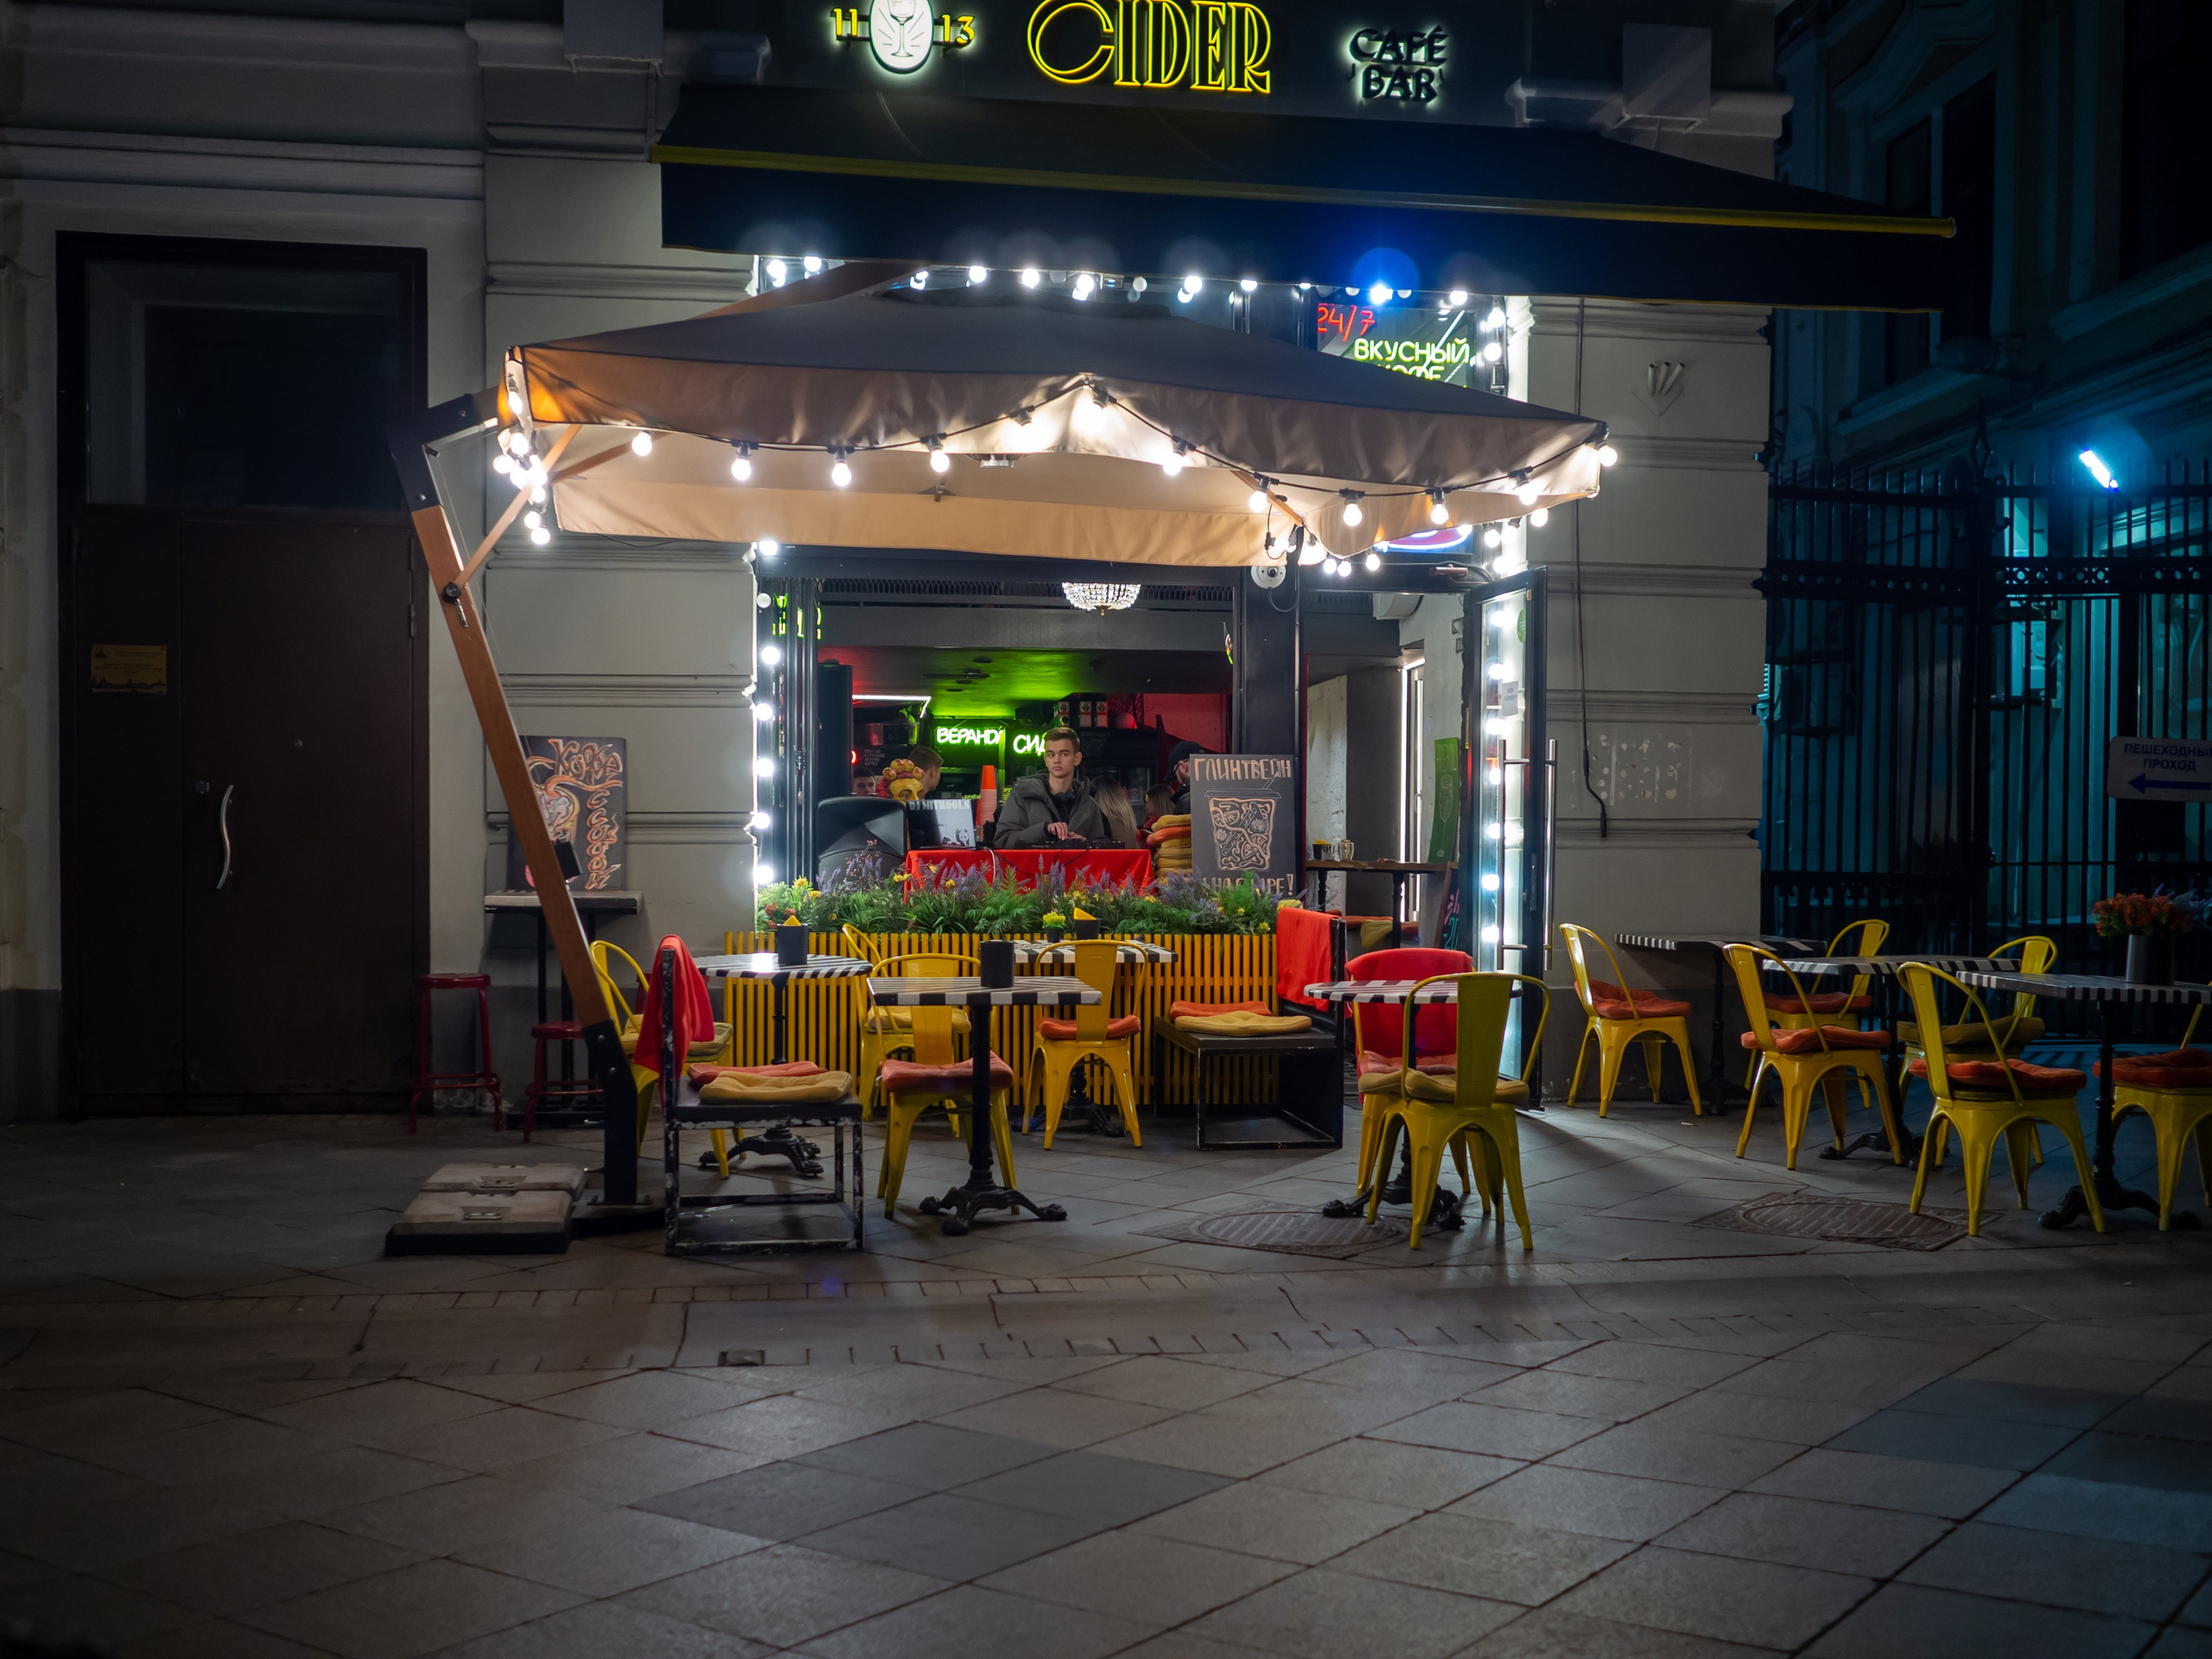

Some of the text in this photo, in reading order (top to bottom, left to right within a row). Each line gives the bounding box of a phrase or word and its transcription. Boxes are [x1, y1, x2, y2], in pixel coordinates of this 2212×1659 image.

[833, 8, 976, 45] 11 13
[1027, 0, 1272, 94] CIDER
[1349, 24, 1450, 67] CAFÉ
[1362, 65, 1438, 103] BAR
[1317, 305, 1376, 342] 24/7
[1353, 337, 1471, 365] ВКУСНЫЙ
[1194, 757, 1293, 782] ГЛИНТВЕЙН
[2143, 758, 2197, 772] ПРОХОД
